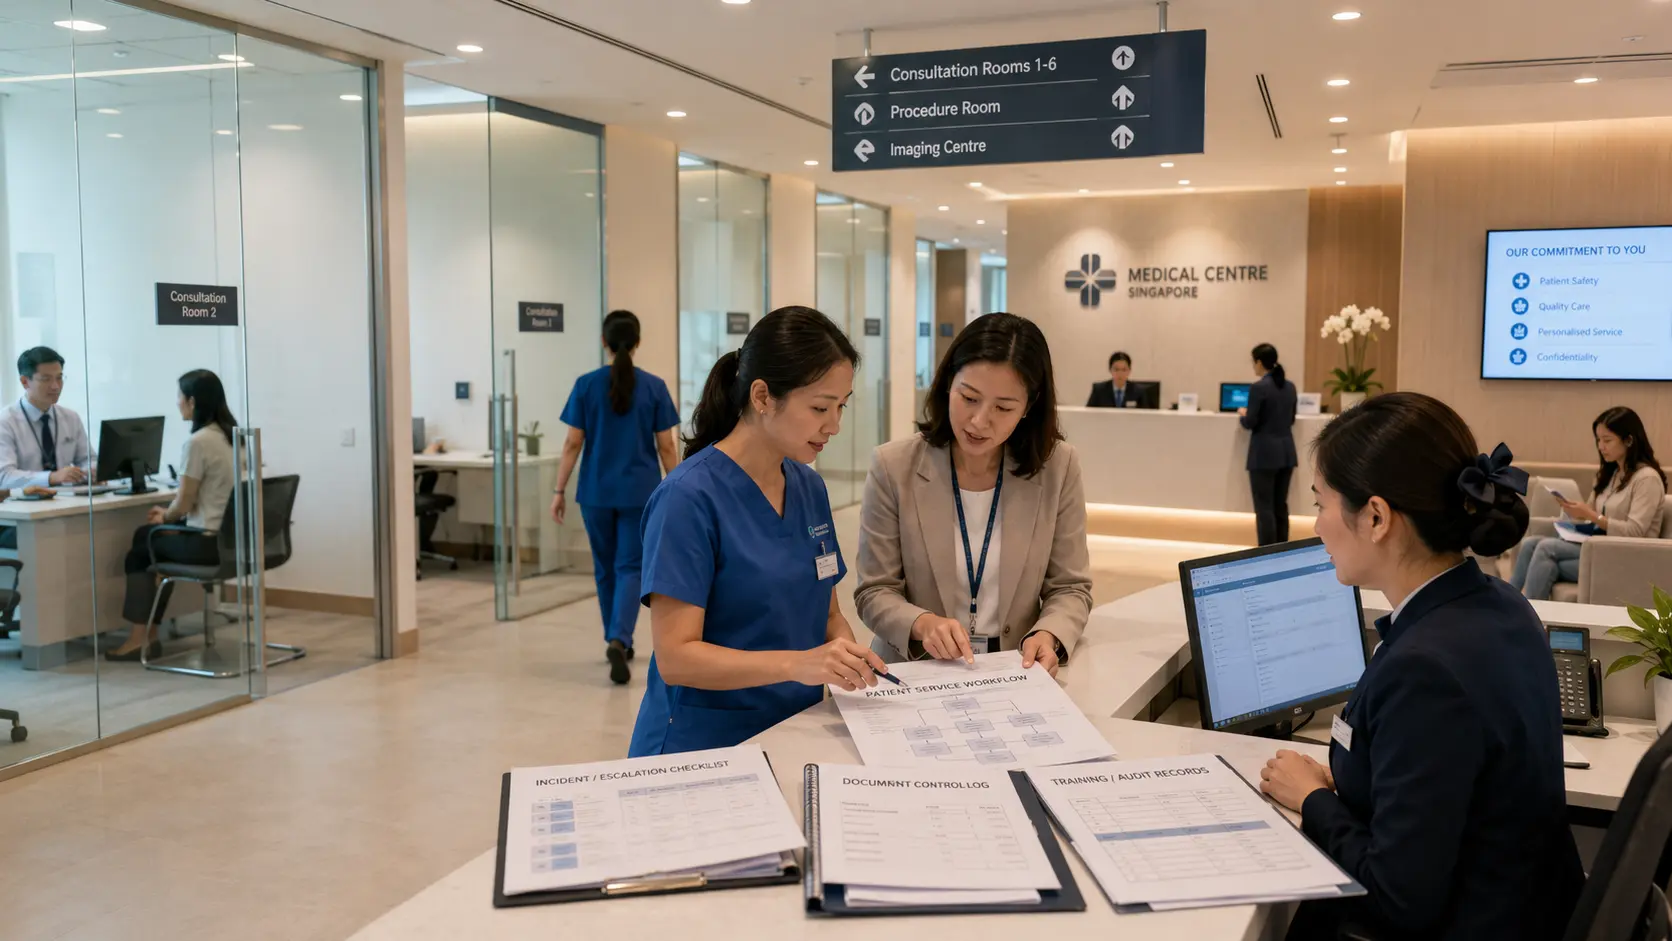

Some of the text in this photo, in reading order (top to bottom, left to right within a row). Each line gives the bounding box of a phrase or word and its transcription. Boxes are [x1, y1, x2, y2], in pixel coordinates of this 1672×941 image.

[890, 56, 1058, 82] Consultation Rooms 1-6
[890, 101, 1001, 119] Procedure Room
[890, 140, 987, 158] Imaging Centre
[1506, 245, 1646, 257] OUR COMMITMENT TO YOU
[1128, 265, 1268, 282] MEDICAL CENTRE
[1539, 276, 1599, 287] Patient Safety
[170, 290, 226, 304] Consultation
[1128, 286, 1198, 298] SINGAPORE
[182, 306, 216, 318] Room 2
[1538, 302, 1590, 312] Quality Care
[1538, 327, 1623, 336] Personalised Service
[1536, 352, 1598, 363] Confidentiality
[866, 674, 1028, 698] PATIENT SERVICE WORKFLOW
[536, 775, 590, 786] INCIDENT
[600, 767, 667, 781] ESCALATION
[1050, 774, 1109, 786] TRAINING
[1118, 771, 1152, 781] AUDIT
[1154, 766, 1210, 778] RECORDS
